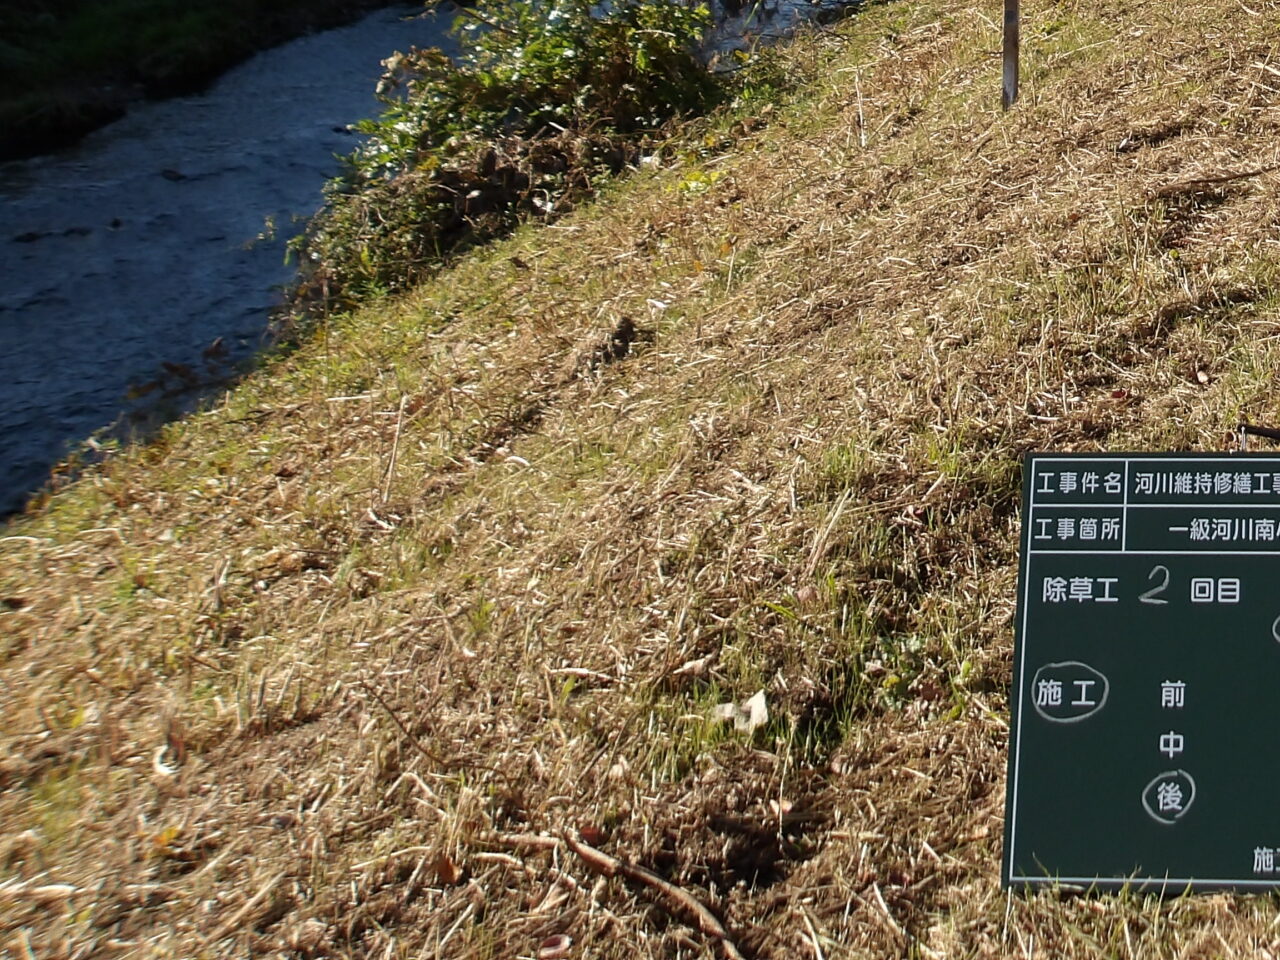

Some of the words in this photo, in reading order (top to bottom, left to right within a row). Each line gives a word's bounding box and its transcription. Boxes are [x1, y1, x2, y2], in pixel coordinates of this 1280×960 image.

[1037, 471, 1121, 494] 工事件名
[1034, 518, 1120, 541] 工事箇所
[1042, 577, 1119, 603] 除草工
[1138, 565, 1170, 604] 2
[1191, 578, 1240, 603] 回目
[1036, 680, 1096, 707] 施工
[1161, 680, 1186, 708] 前
[1159, 731, 1184, 759] 中
[1157, 782, 1183, 811] 後
